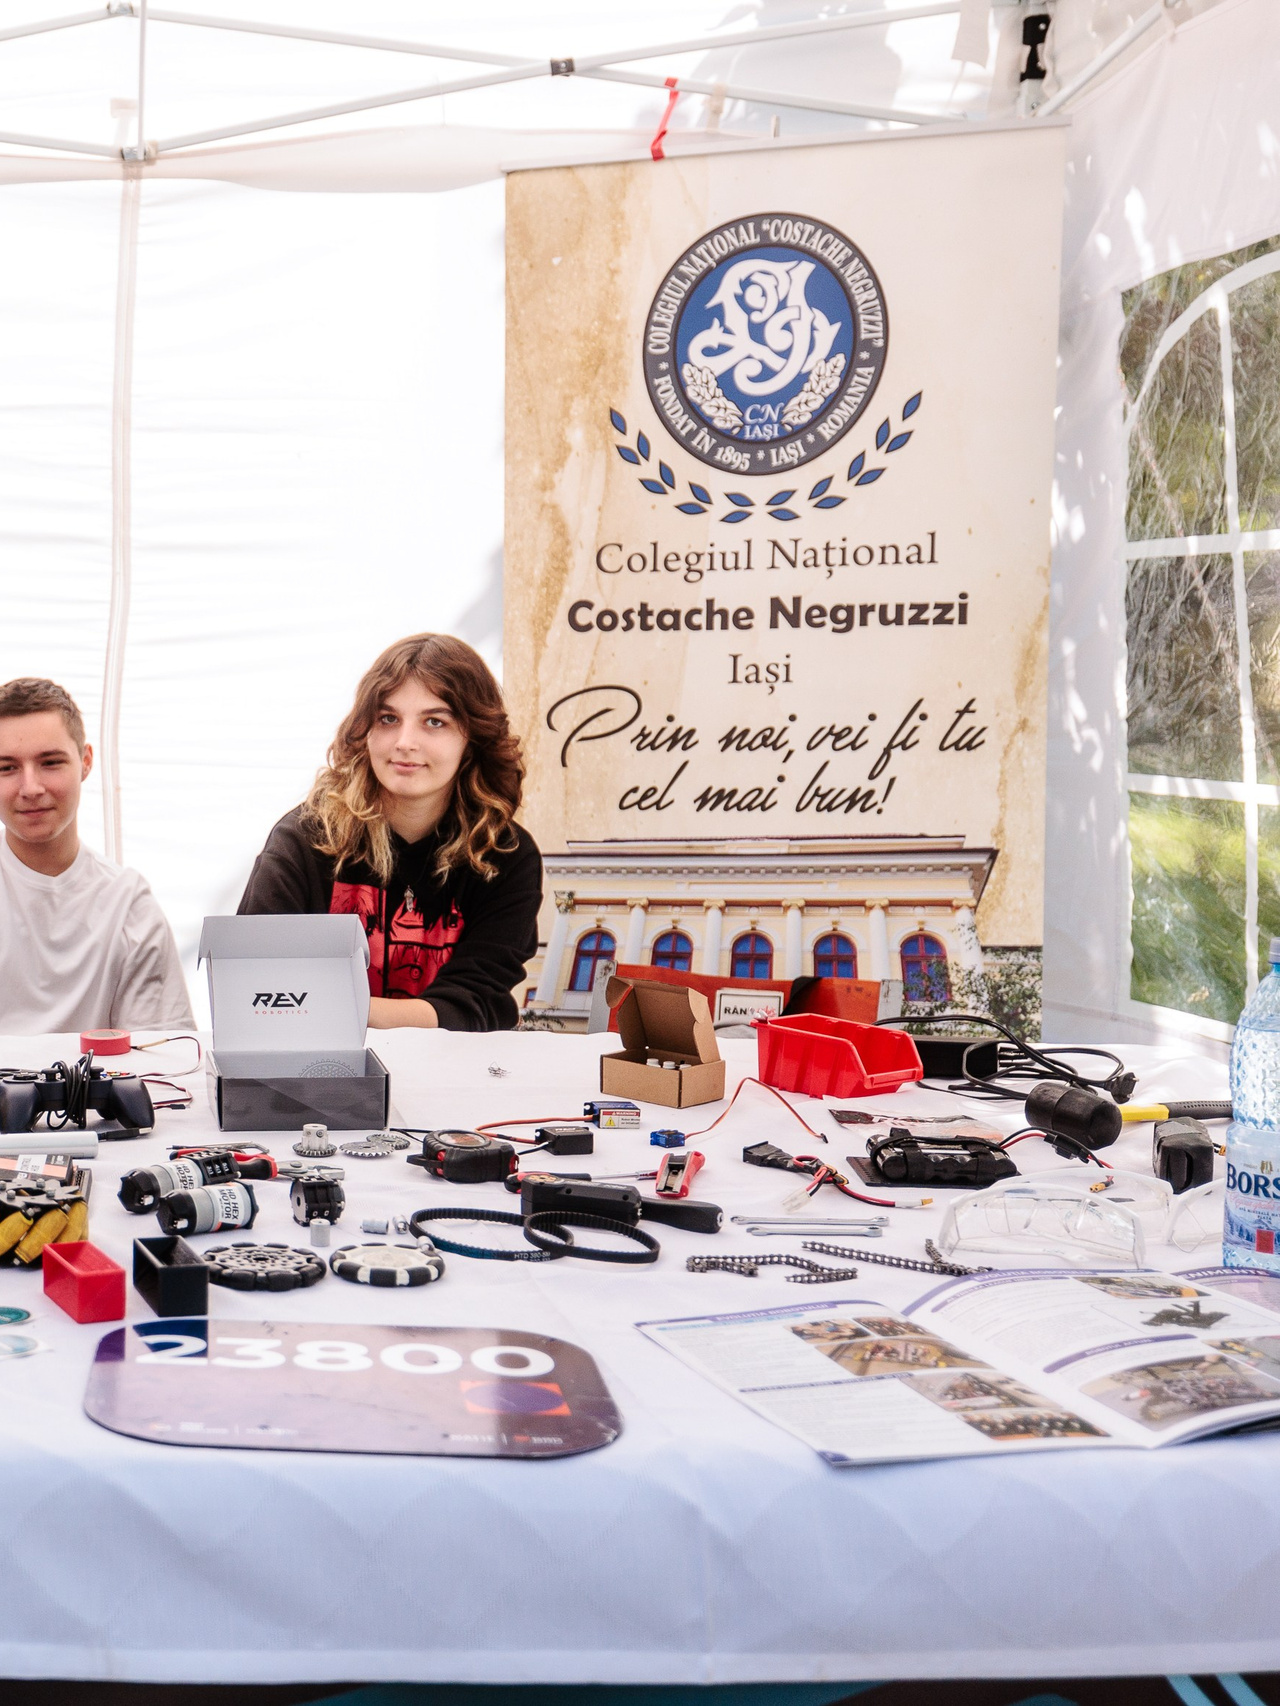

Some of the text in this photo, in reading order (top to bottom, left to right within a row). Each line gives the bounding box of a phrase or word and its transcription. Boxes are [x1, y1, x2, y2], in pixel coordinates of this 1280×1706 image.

[647, 274, 692, 355] COLEGIUL
[652, 376, 698, 438] FONDAT
[690, 423, 718, 455] ÎN
[714, 444, 752, 471] 1895
[743, 402, 785, 424] CN
[595, 531, 940, 584] Colegiul Național
[567, 592, 970, 633] Costache Negruzzi
[727, 652, 794, 695] Iași
[546, 684, 991, 780] Prin noi, vei fi tu
[618, 760, 896, 816] cel mai bun!
[251, 991, 309, 1008] REV
[218, 1188, 232, 1219] MOTOR
[225, 1188, 239, 1220] HD HEX
[134, 1333, 556, 1377] 23800
